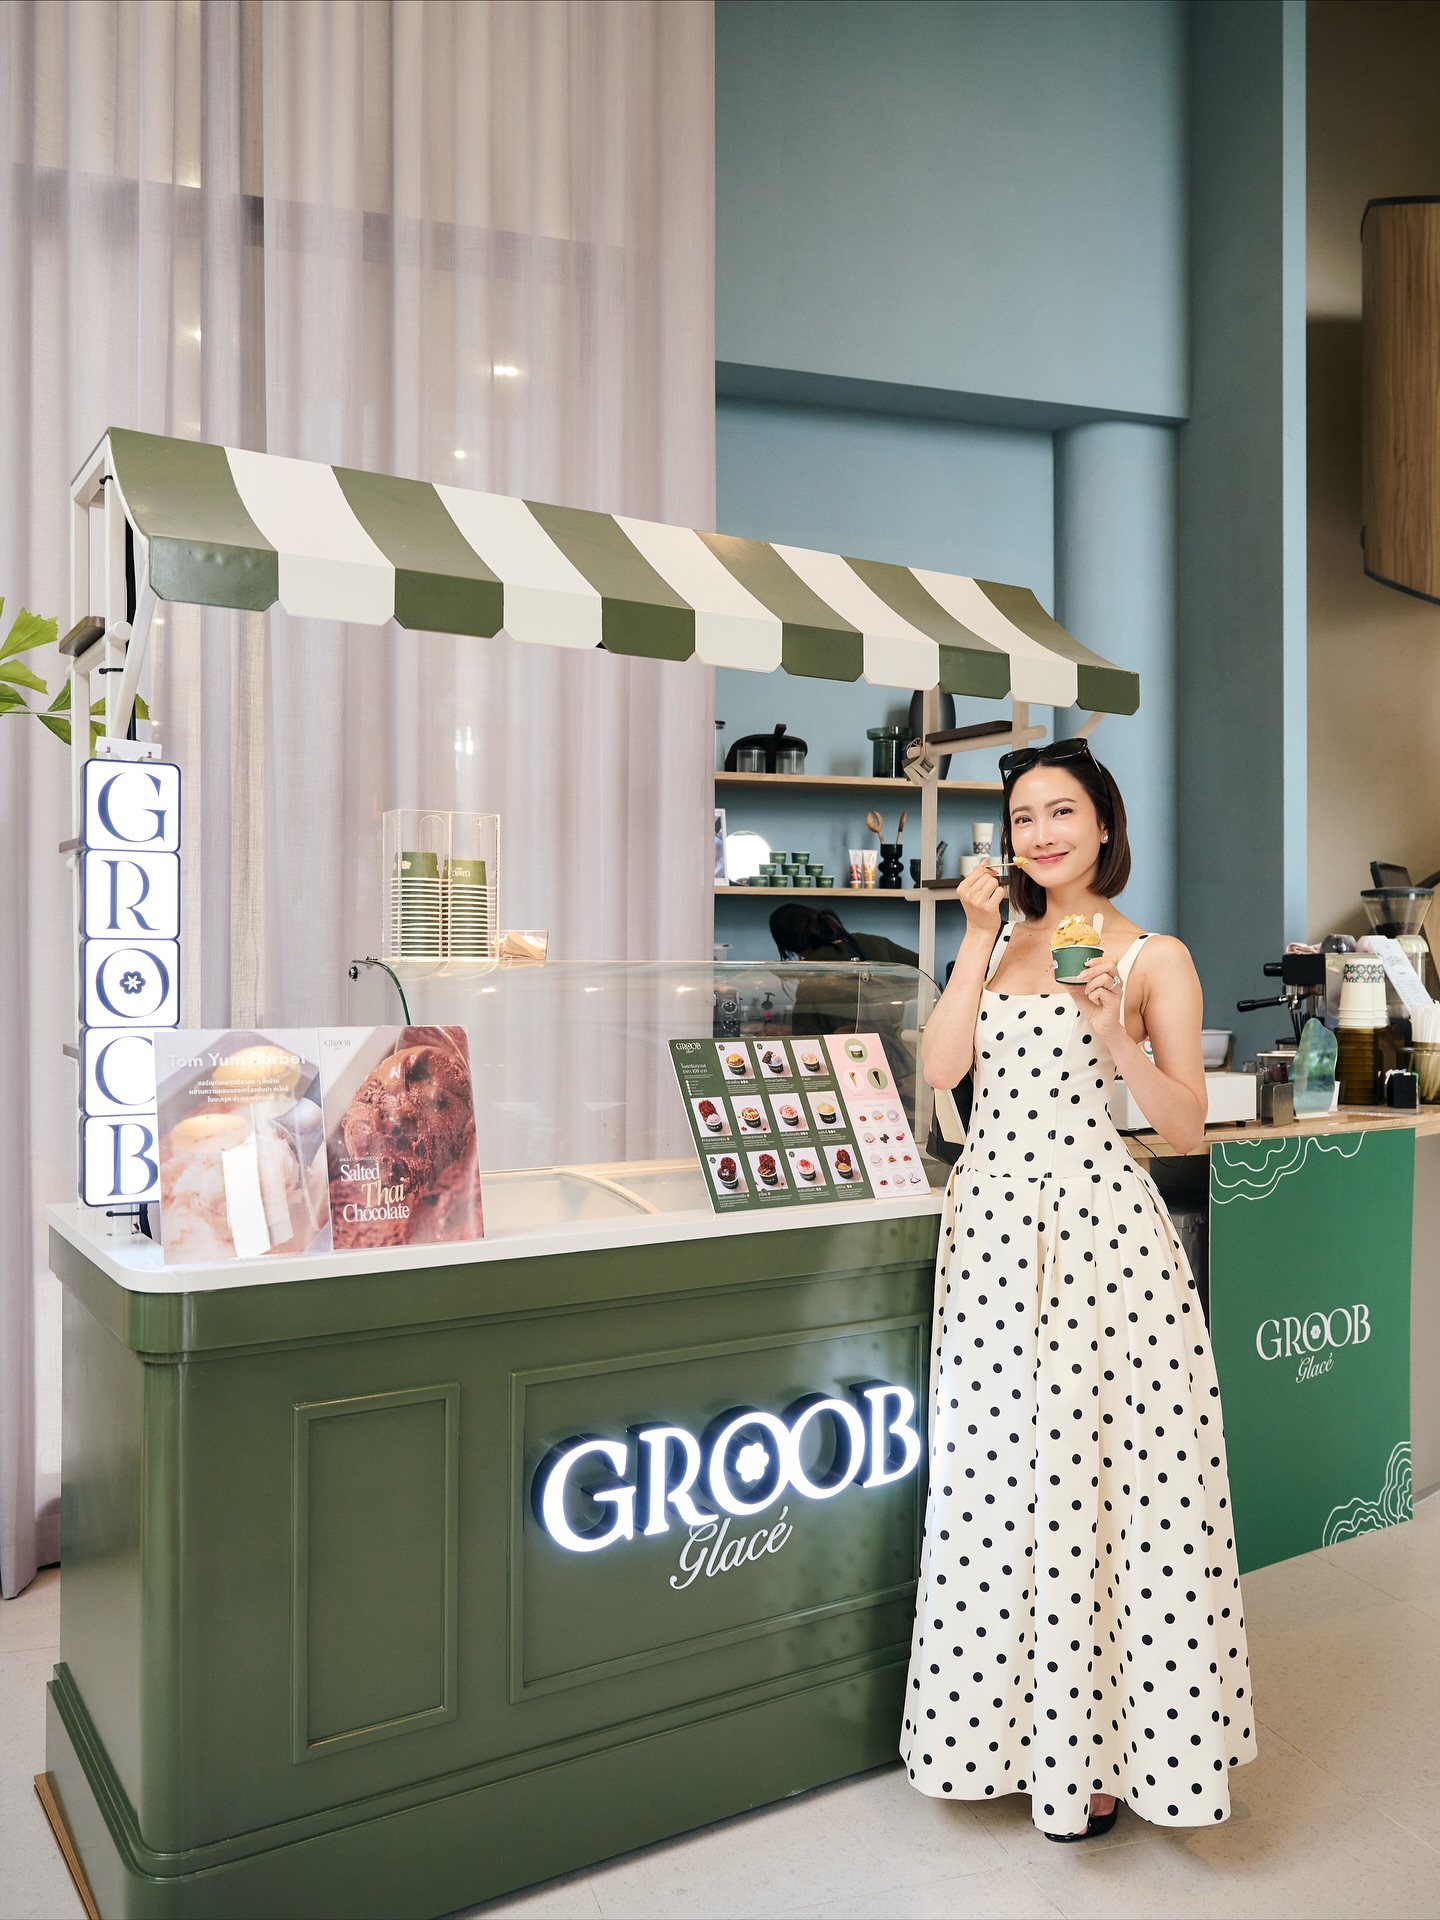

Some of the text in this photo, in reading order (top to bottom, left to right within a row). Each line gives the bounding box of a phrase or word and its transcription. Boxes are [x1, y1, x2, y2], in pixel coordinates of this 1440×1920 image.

[324, 1039, 352, 1047] GROOB
[675, 1042, 702, 1051] GROOB
[168, 1051, 307, 1068] Tom Yum Sorbet
[340, 1161, 380, 1182] Salted
[361, 1177, 406, 1209] Thai
[342, 1202, 411, 1223] Chocolate
[1255, 1303, 1371, 1361] GROOB
[1295, 1352, 1334, 1384] Glacé
[541, 1384, 922, 1554] GROOB
[669, 1506, 794, 1591] Glacé
